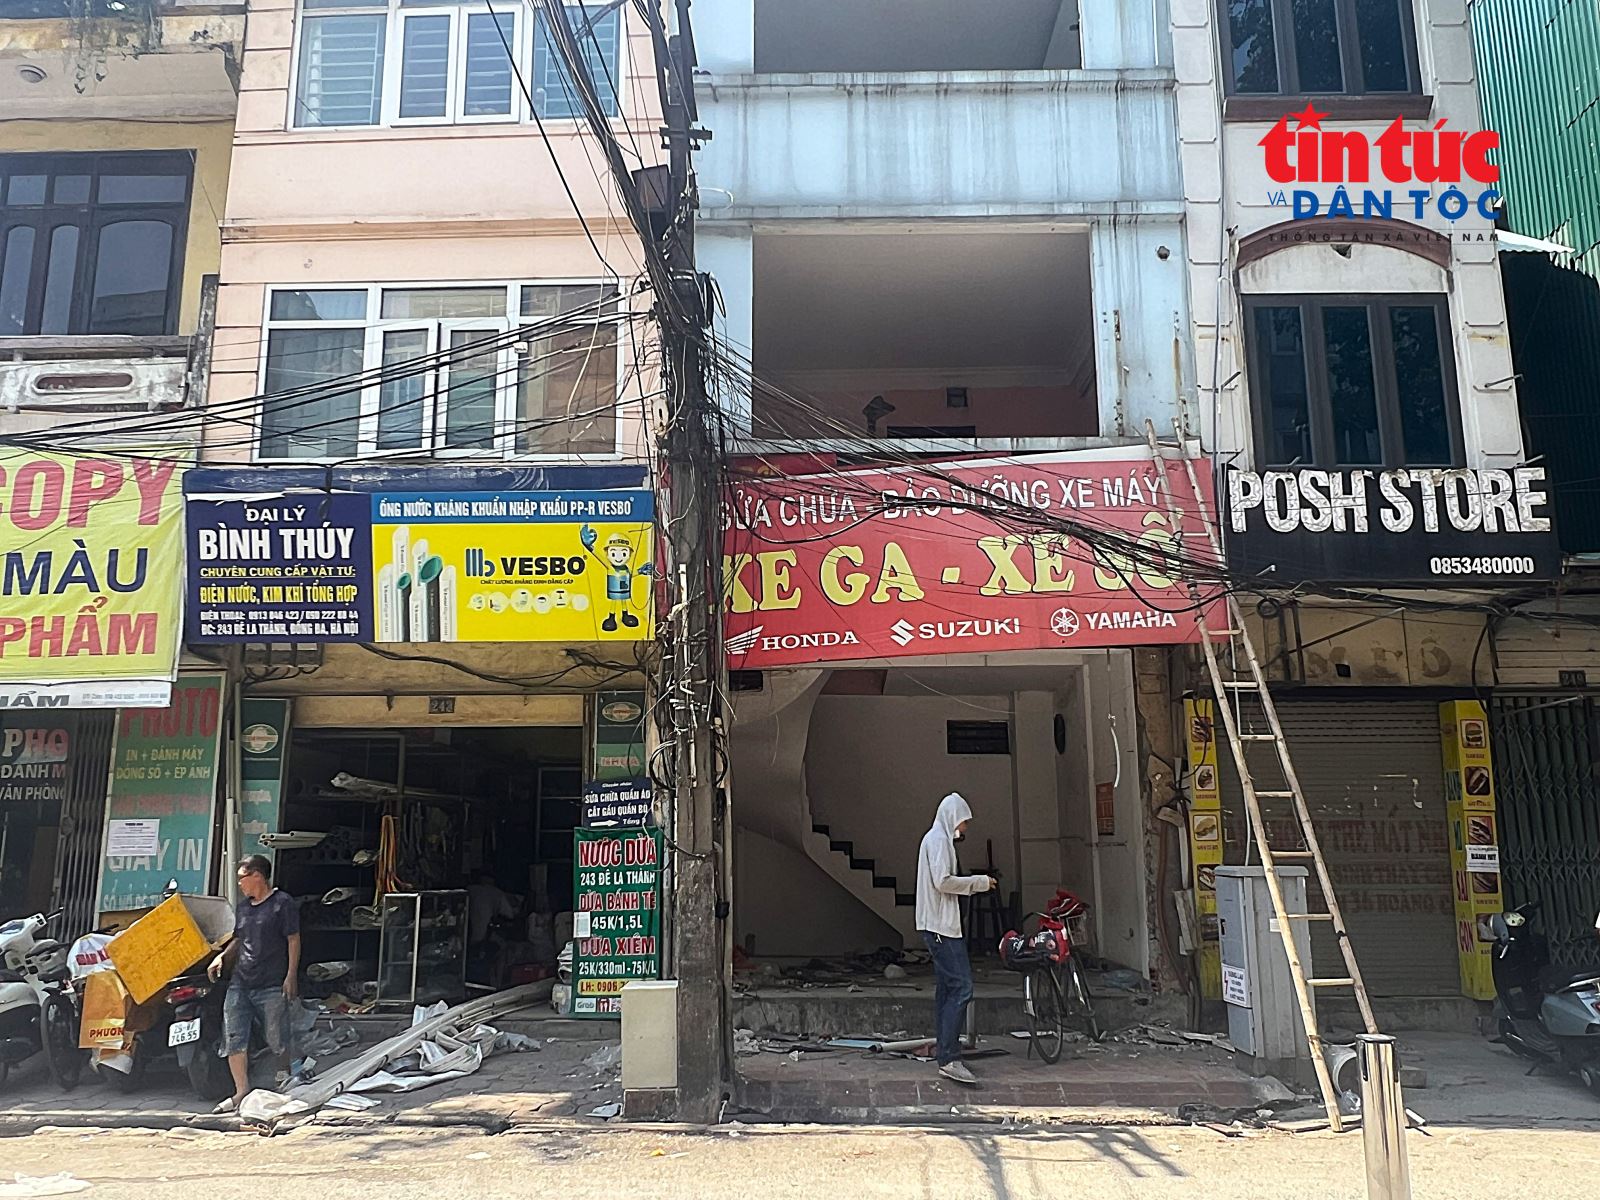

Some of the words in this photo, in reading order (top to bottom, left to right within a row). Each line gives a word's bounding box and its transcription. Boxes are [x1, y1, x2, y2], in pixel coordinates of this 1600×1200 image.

[0, 458, 178, 530] OPY
[1058, 478, 1095, 508] XE
[1103, 469, 1161, 507] MÁY
[1228, 469, 1369, 532] POSH
[1380, 467, 1551, 532] STORE
[246, 508, 279, 525] ĐẠI
[284, 505, 306, 521] LÝ
[379, 498, 401, 517] ỐNG
[404, 498, 432, 516] NƯỚC
[471, 496, 506, 516] KHUẨN
[509, 499, 538, 519] NHẬP
[540, 496, 568, 516] KHẨU
[570, 501, 595, 516] PP-R
[199, 523, 271, 560] BÌNH
[279, 522, 354, 559] THÚY
[3, 539, 148, 595] MÀU
[200, 565, 246, 577] CHUYÊN
[249, 567, 281, 577] CUNG
[284, 564, 308, 577] CẤP
[311, 565, 334, 578] VẬT
[501, 556, 586, 576] VESBO
[819, 542, 925, 606] GA
[976, 531, 1075, 596] XE
[1430, 557, 1534, 574] 0853480000
[200, 584, 225, 607] ĐIỆN
[262, 586, 283, 603] KIM
[285, 582, 303, 603] KHÍ
[306, 580, 333, 603] TỔNG
[336, 585, 357, 606] HỢP
[321, 611, 336, 620] 222
[246, 624, 258, 635] LA
[761, 630, 860, 651] HONDA
[919, 617, 1020, 639] SUZUKI
[1084, 611, 1177, 630] YAMAHA
[182, 744, 204, 760] MÁY
[177, 838, 204, 871] IN
[578, 837, 622, 867] NƯỚC
[624, 833, 657, 866] DỪA
[580, 872, 596, 886] 243
[598, 869, 611, 885] ĐÊ
[613, 872, 624, 885] LA
[626, 868, 655, 884] THÀNH
[578, 889, 604, 911] DỪA
[606, 888, 640, 911] BÁNH
[591, 915, 643, 931] 45K/1,5L
[615, 932, 656, 955] XIÊM
[579, 961, 626, 976] 25K/330ml
[632, 960, 657, 975] 75K/L
[580, 981, 595, 992] LH:
